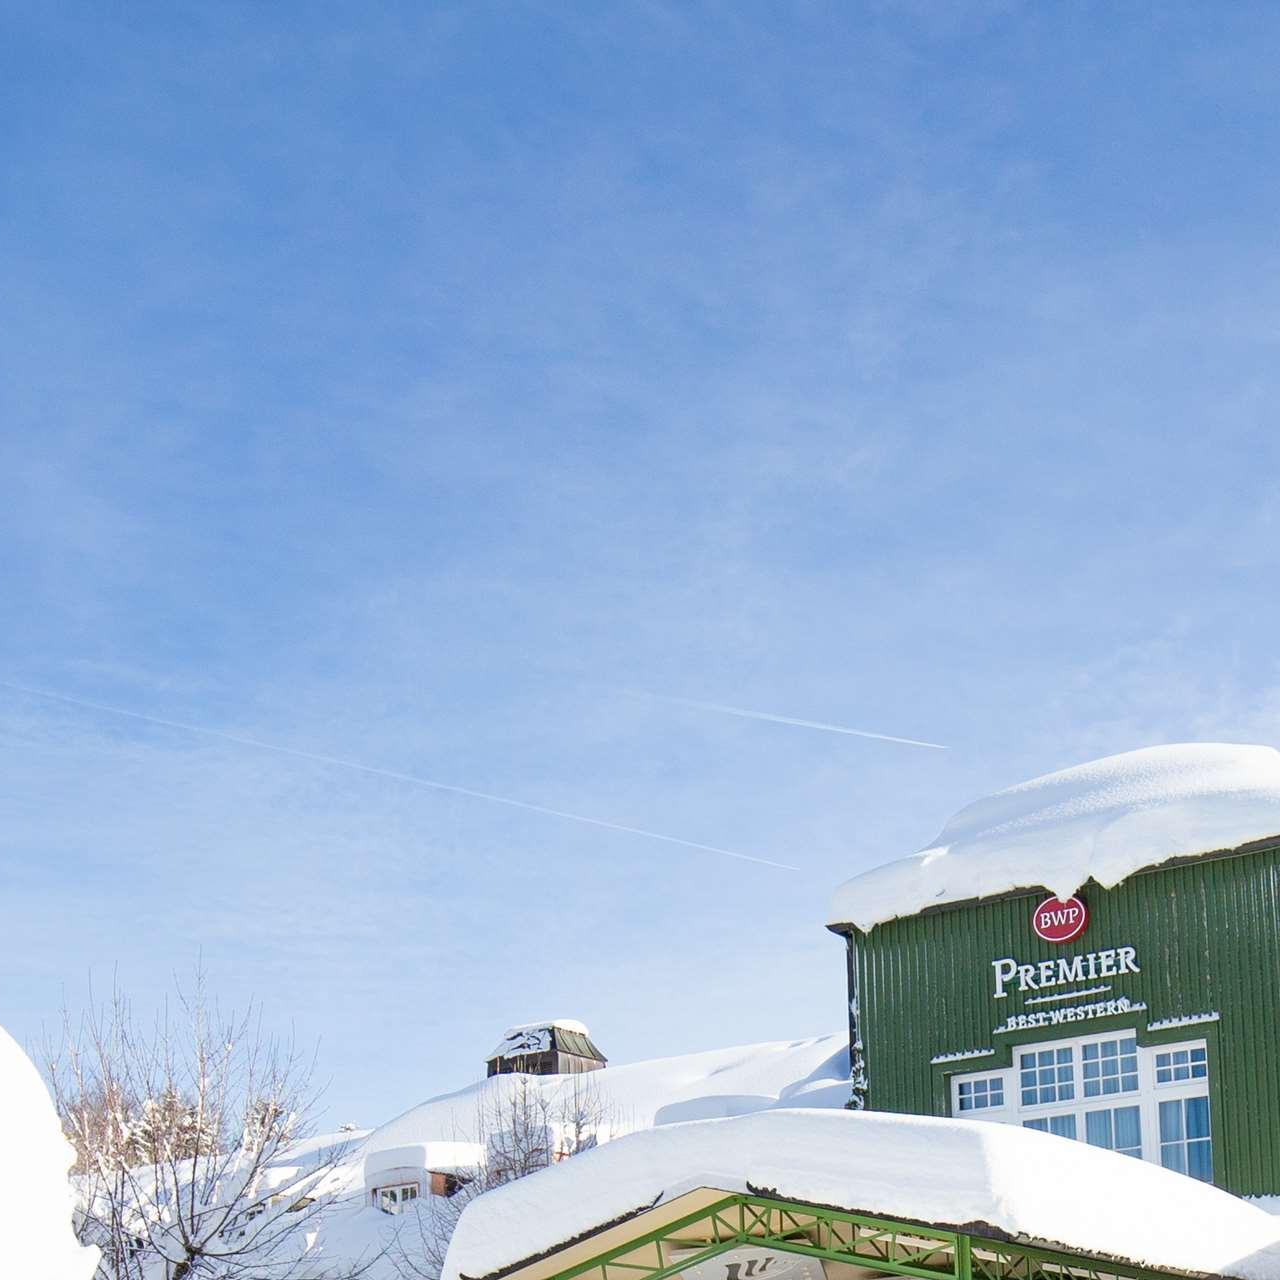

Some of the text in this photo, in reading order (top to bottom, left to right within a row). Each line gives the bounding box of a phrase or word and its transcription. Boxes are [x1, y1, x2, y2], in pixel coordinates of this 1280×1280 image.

[1040, 907, 1079, 929] BWP
[991, 946, 1141, 998] PREMIER
[1006, 998, 1133, 1031] BEST WESTERN
